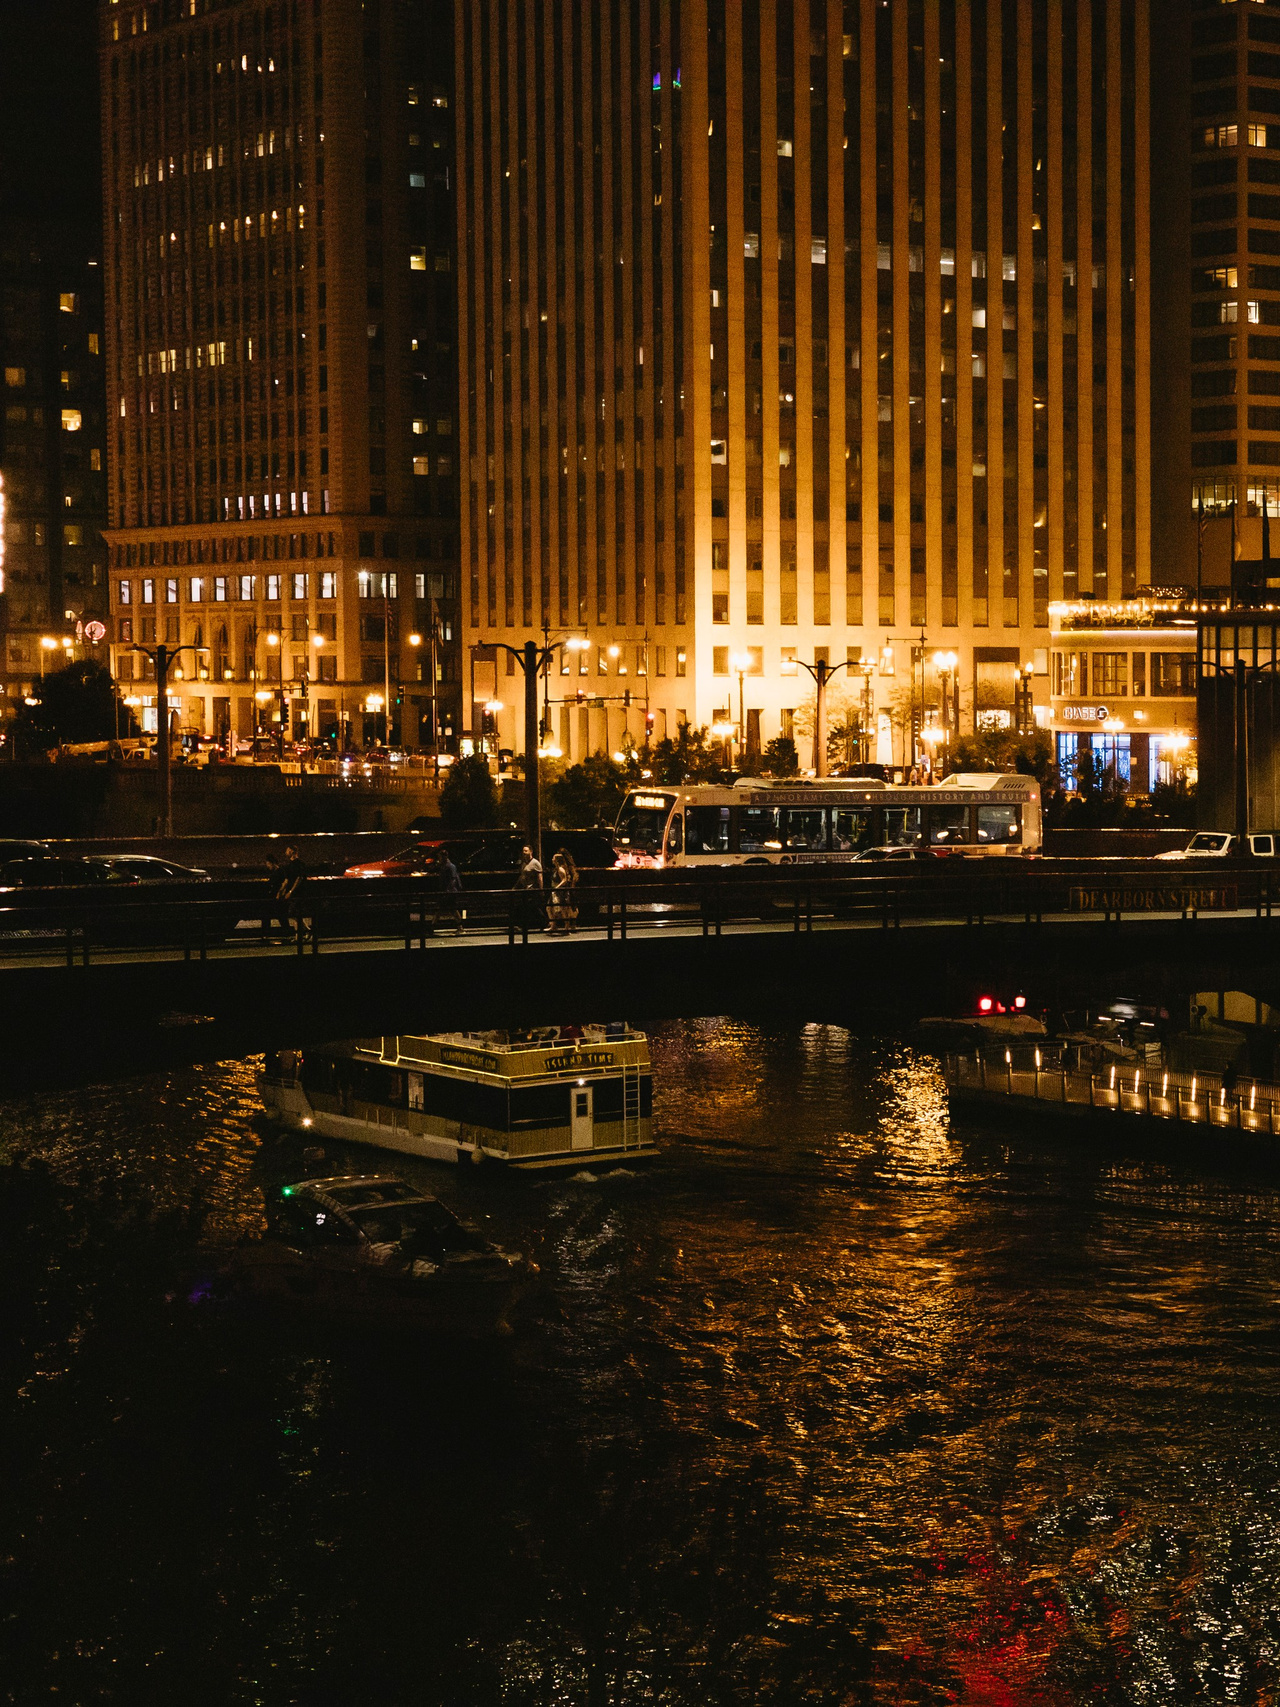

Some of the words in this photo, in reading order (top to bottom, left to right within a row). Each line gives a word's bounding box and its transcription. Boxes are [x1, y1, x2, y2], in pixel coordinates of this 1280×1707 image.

[1063, 706, 1096, 721] CHASE
[766, 793, 830, 802] PANORAMIC
[836, 793, 860, 802] VIEW
[865, 792, 914, 801] HROUGH
[920, 792, 964, 801] HISTORY
[971, 792, 990, 801] AND
[996, 792, 1028, 801] TRUTH
[1079, 888, 1165, 910] DEARBORN
[1169, 886, 1229, 908] STREET
[546, 1054, 583, 1069] ISLAND
[588, 1053, 613, 1064] TIME
